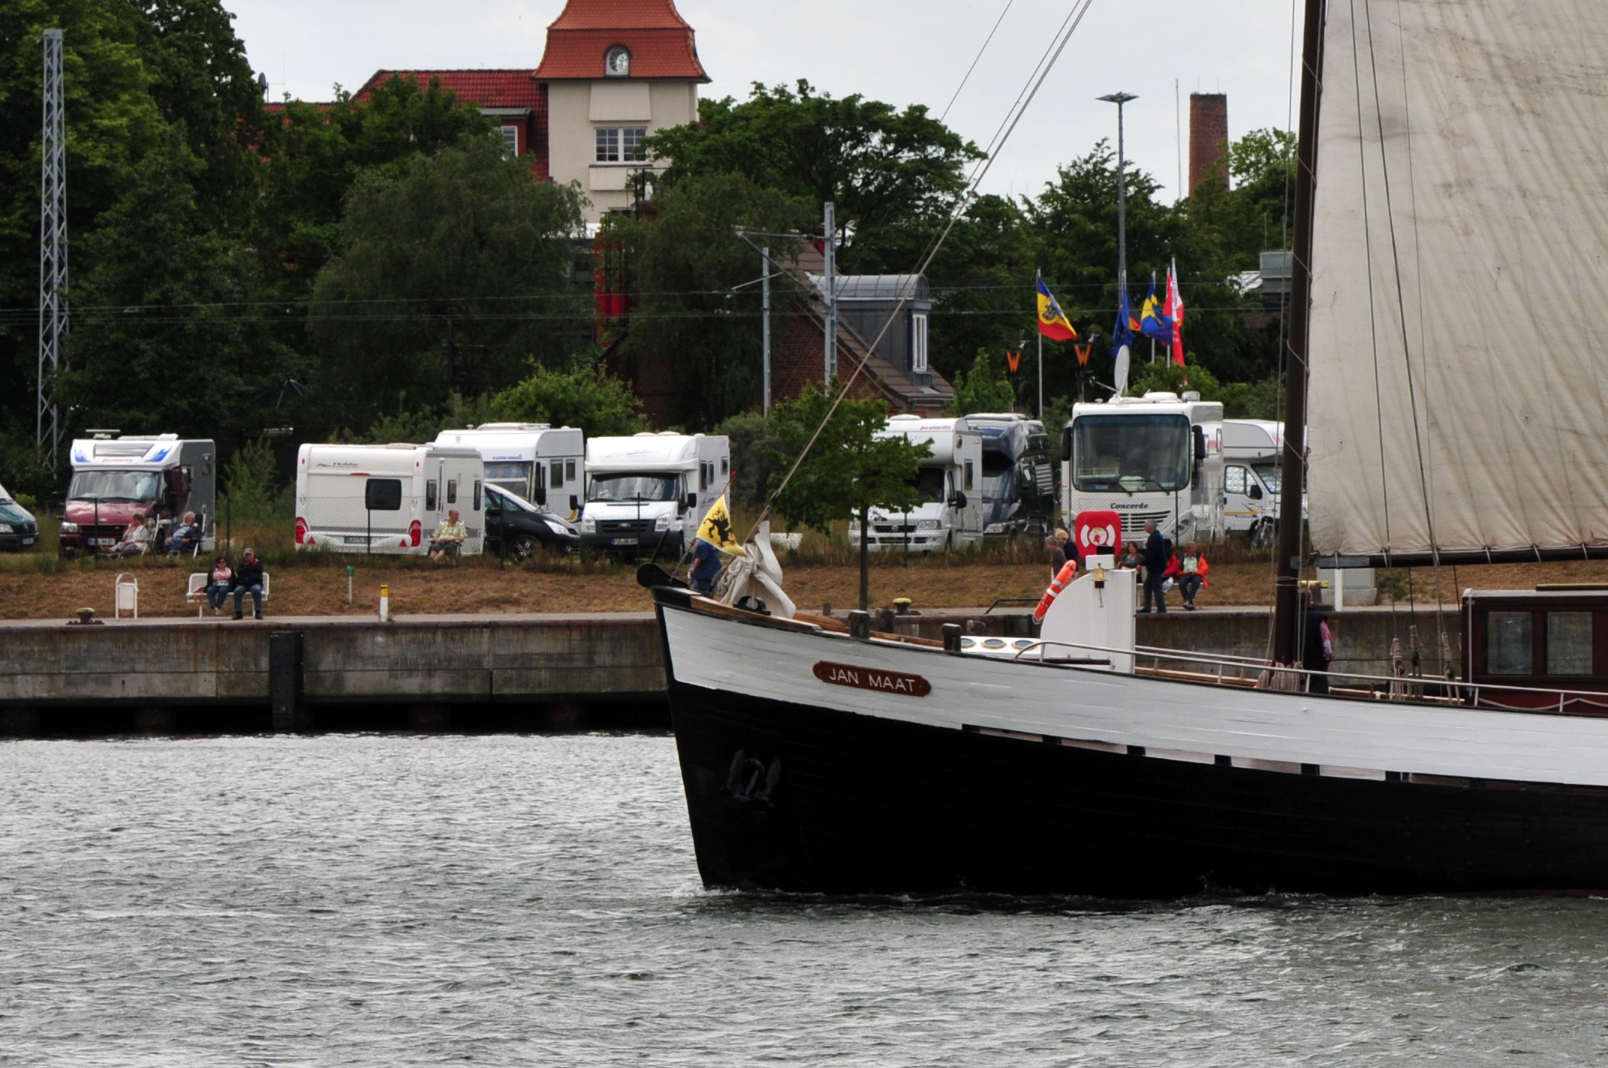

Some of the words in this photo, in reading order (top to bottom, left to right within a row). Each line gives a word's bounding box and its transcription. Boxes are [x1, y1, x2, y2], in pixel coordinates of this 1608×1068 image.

[1110, 502, 1149, 510] Concorde
[828, 668, 859, 685] JAN
[868, 673, 916, 693] MAAT
